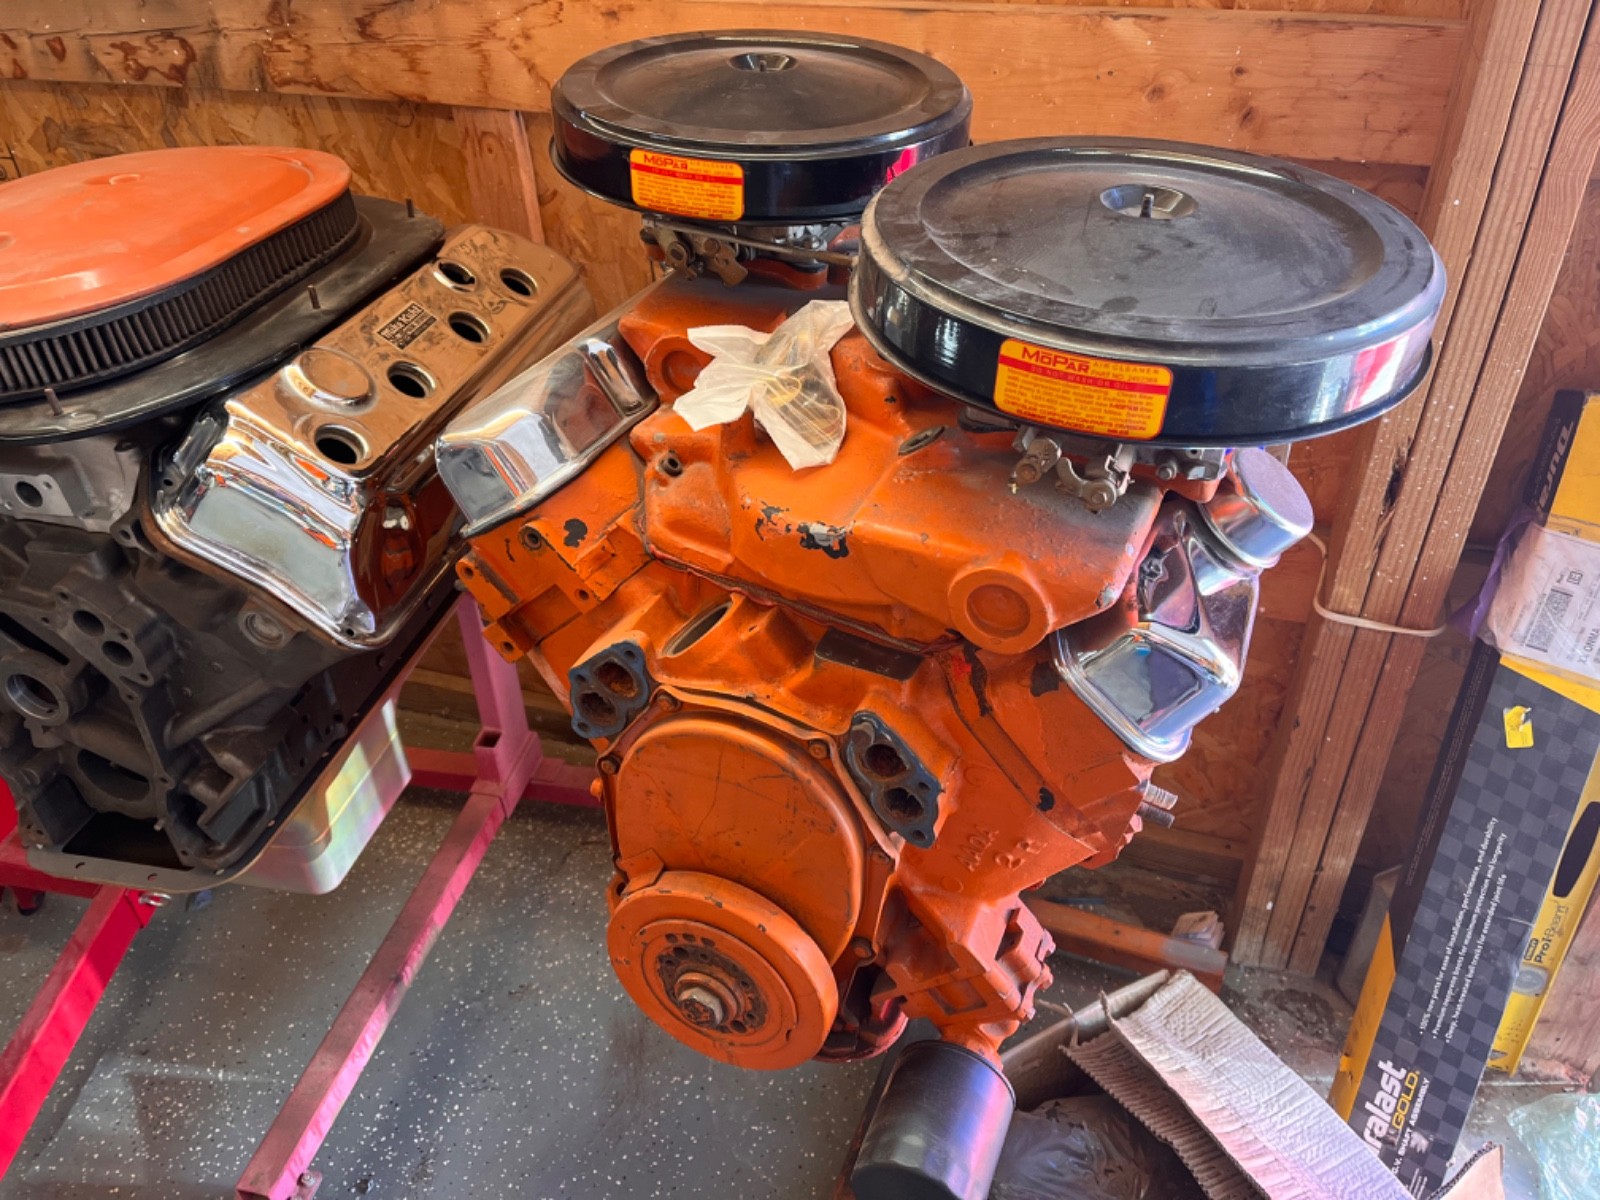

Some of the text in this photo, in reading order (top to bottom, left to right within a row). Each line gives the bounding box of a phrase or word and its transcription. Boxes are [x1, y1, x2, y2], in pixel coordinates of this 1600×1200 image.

[1022, 346, 1089, 374] MOPAR
[1535, 419, 1574, 512] Dura
[1479, 815, 1498, 850] durability
[1489, 831, 1507, 865] longevity
[1475, 849, 1485, 863] and
[1485, 864, 1495, 878] and
[1436, 970, 1444, 981] for
[1440, 955, 1450, 970] ease
[1363, 1060, 1407, 1153] ralast
[1391, 1073, 1418, 1130] GOLD
[1398, 1126, 1414, 1156] SHAFT
[1408, 1077, 1430, 1126] ASSEMBLY
